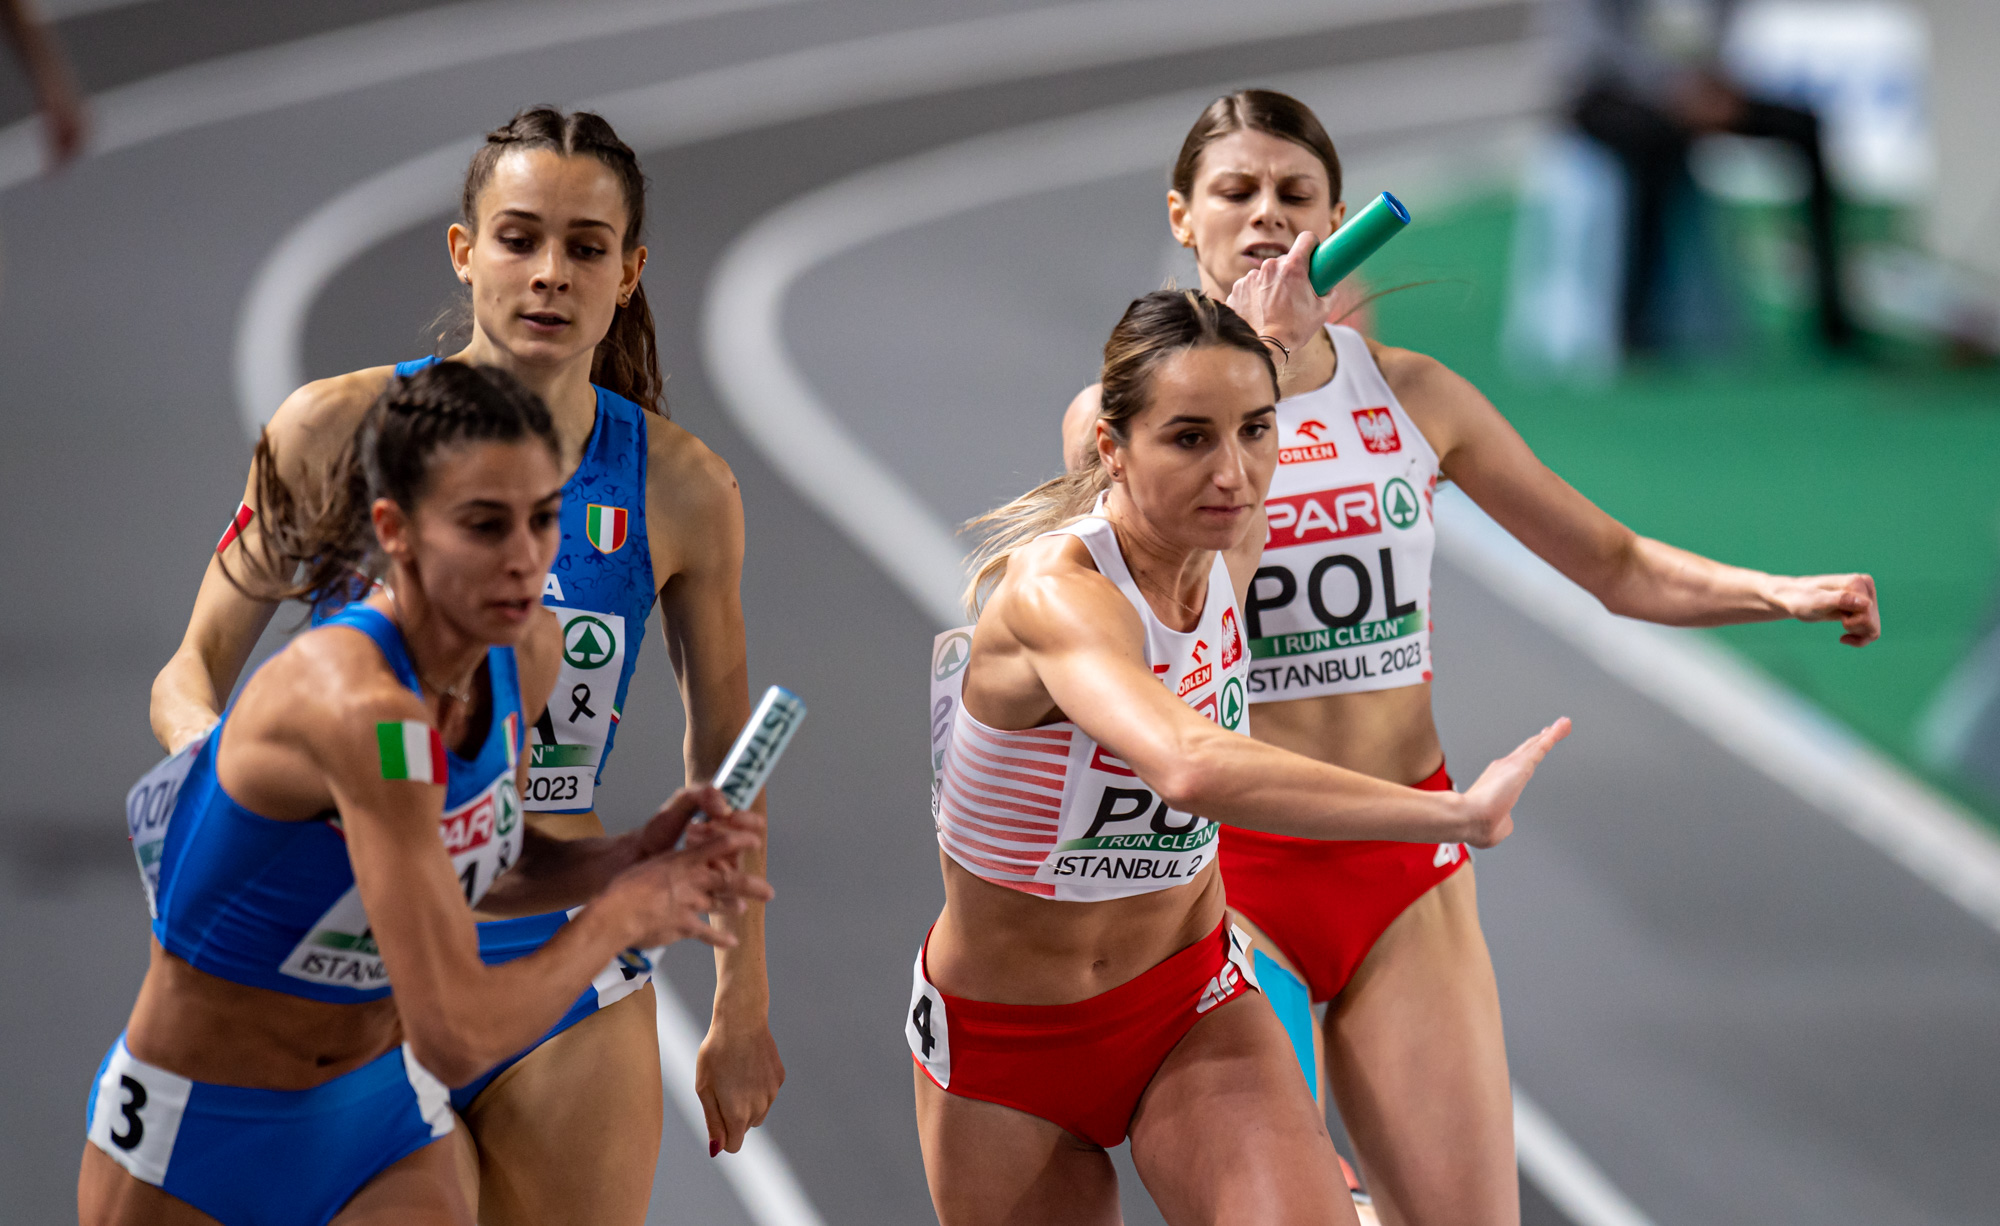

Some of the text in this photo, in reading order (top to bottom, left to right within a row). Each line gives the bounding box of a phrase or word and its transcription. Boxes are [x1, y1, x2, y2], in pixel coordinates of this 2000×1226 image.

[1279, 445, 1334, 463] ORLEN
[1265, 490, 1378, 544] PAR
[1245, 547, 1417, 640] POL
[1273, 638, 1280, 655] I
[1286, 632, 1331, 653] RUN
[1380, 642, 1422, 675] 2023
[1178, 667, 1211, 696] ORLEN
[722, 701, 796, 811] ISTAN
[1082, 786, 1216, 839] PO
[1108, 834, 1155, 848] RUN
[1053, 856, 1182, 879] ISTANBUL
[913, 994, 935, 1060] 4
[110, 1075, 148, 1151] 3
